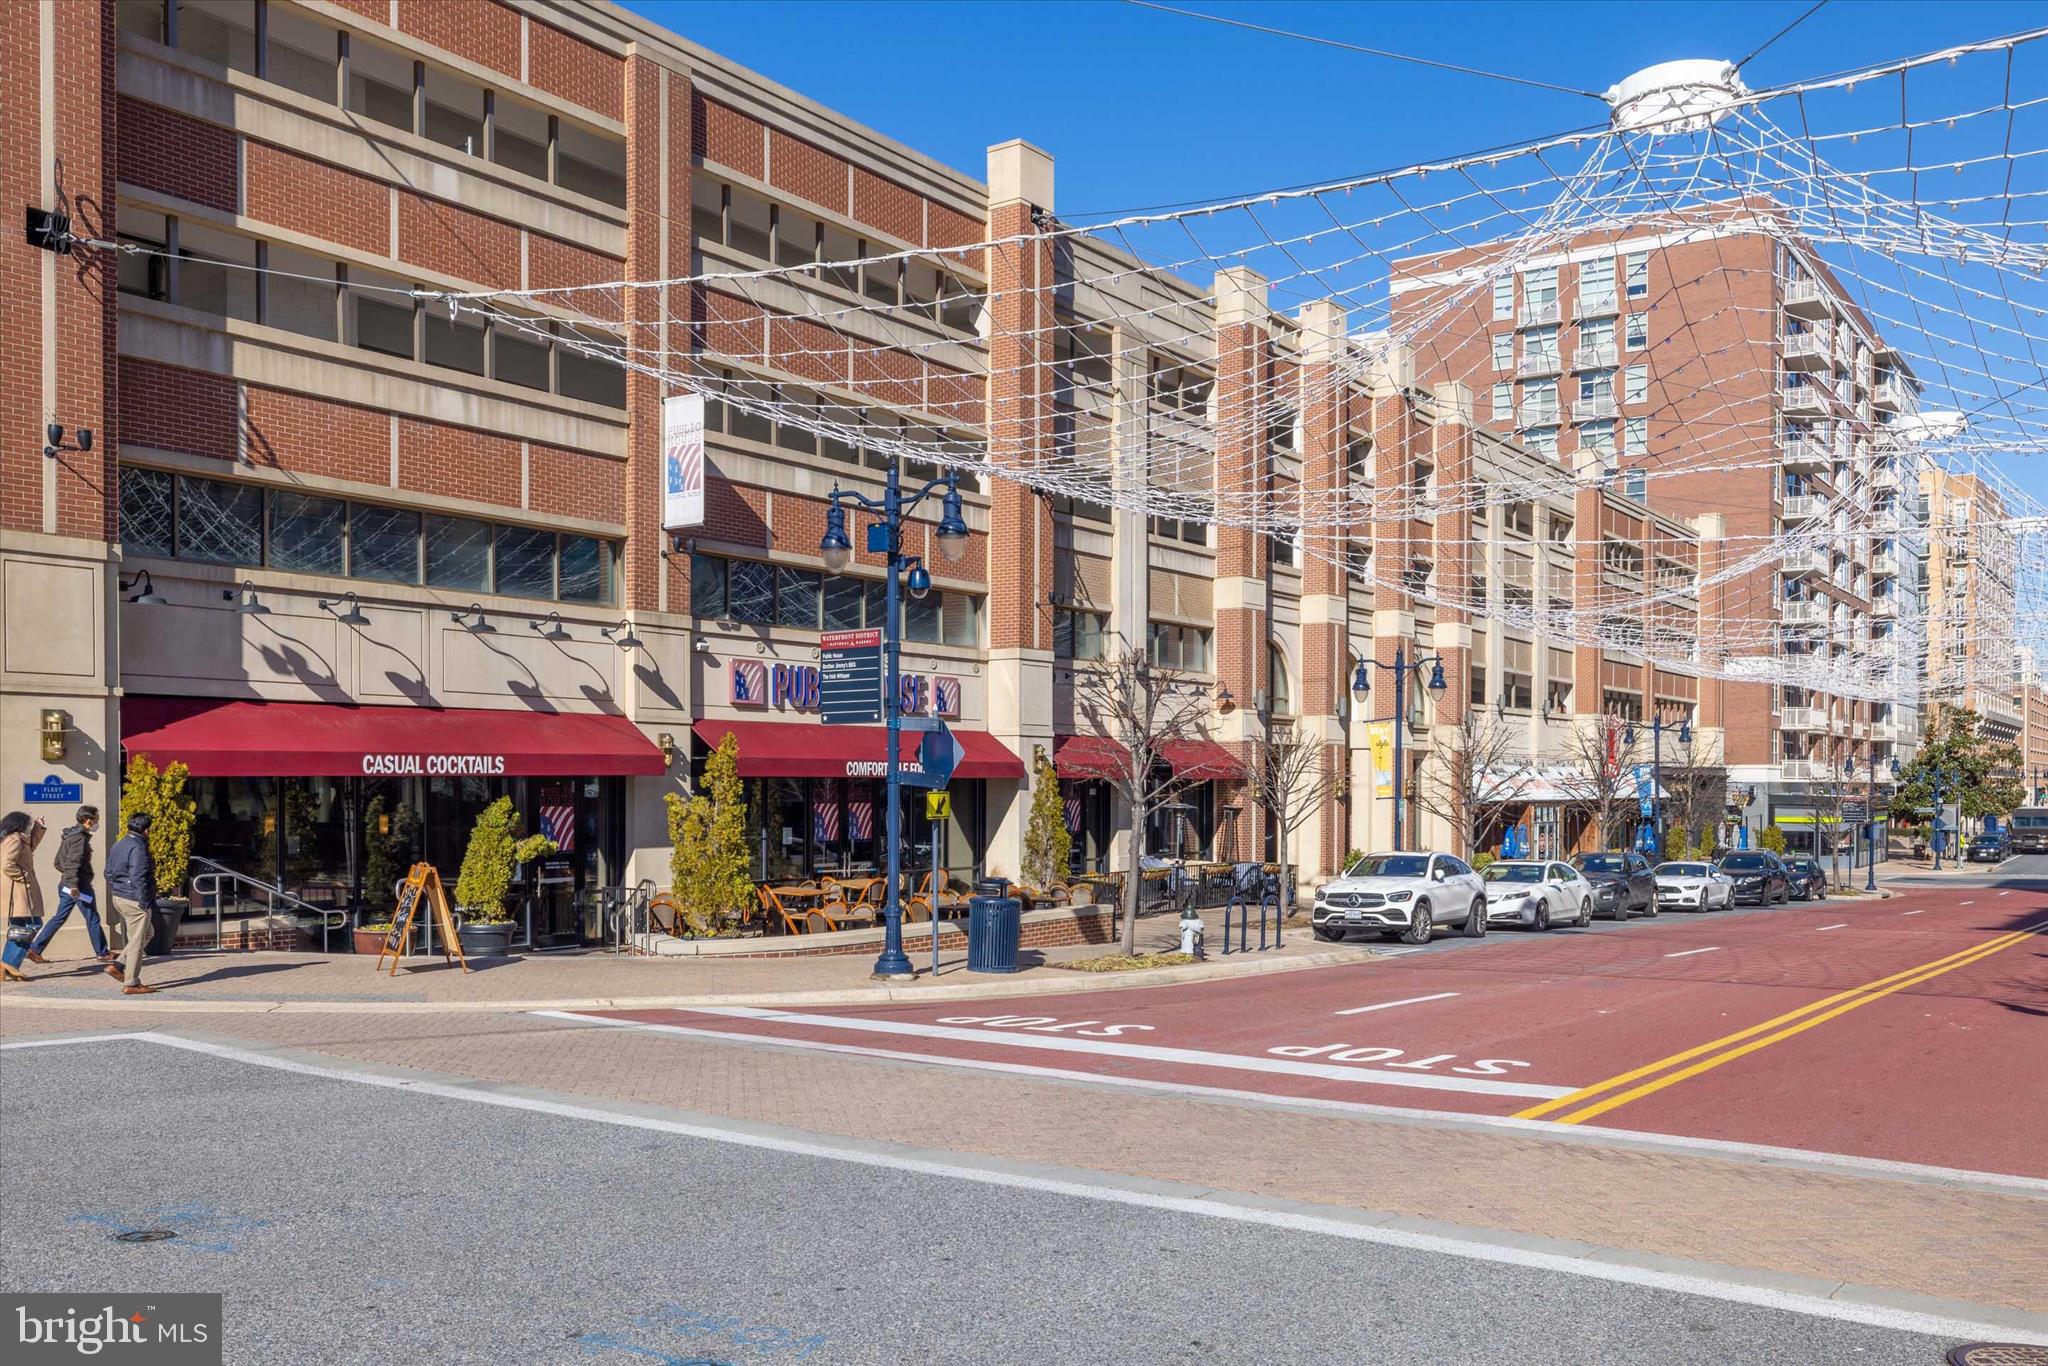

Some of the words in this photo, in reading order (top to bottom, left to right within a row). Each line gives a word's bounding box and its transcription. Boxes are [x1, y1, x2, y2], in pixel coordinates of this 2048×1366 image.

[668, 422, 702, 435] PUBLIC
[822, 633, 855, 641] WATERFRONT
[855, 631, 879, 639] DISTRICT
[772, 663, 820, 708] PUB
[363, 754, 424, 774] CASUAL
[426, 755, 505, 774] COCKTAILS
[936, 1015, 1155, 1036] STOP
[1267, 1043, 1531, 1074] STOP
